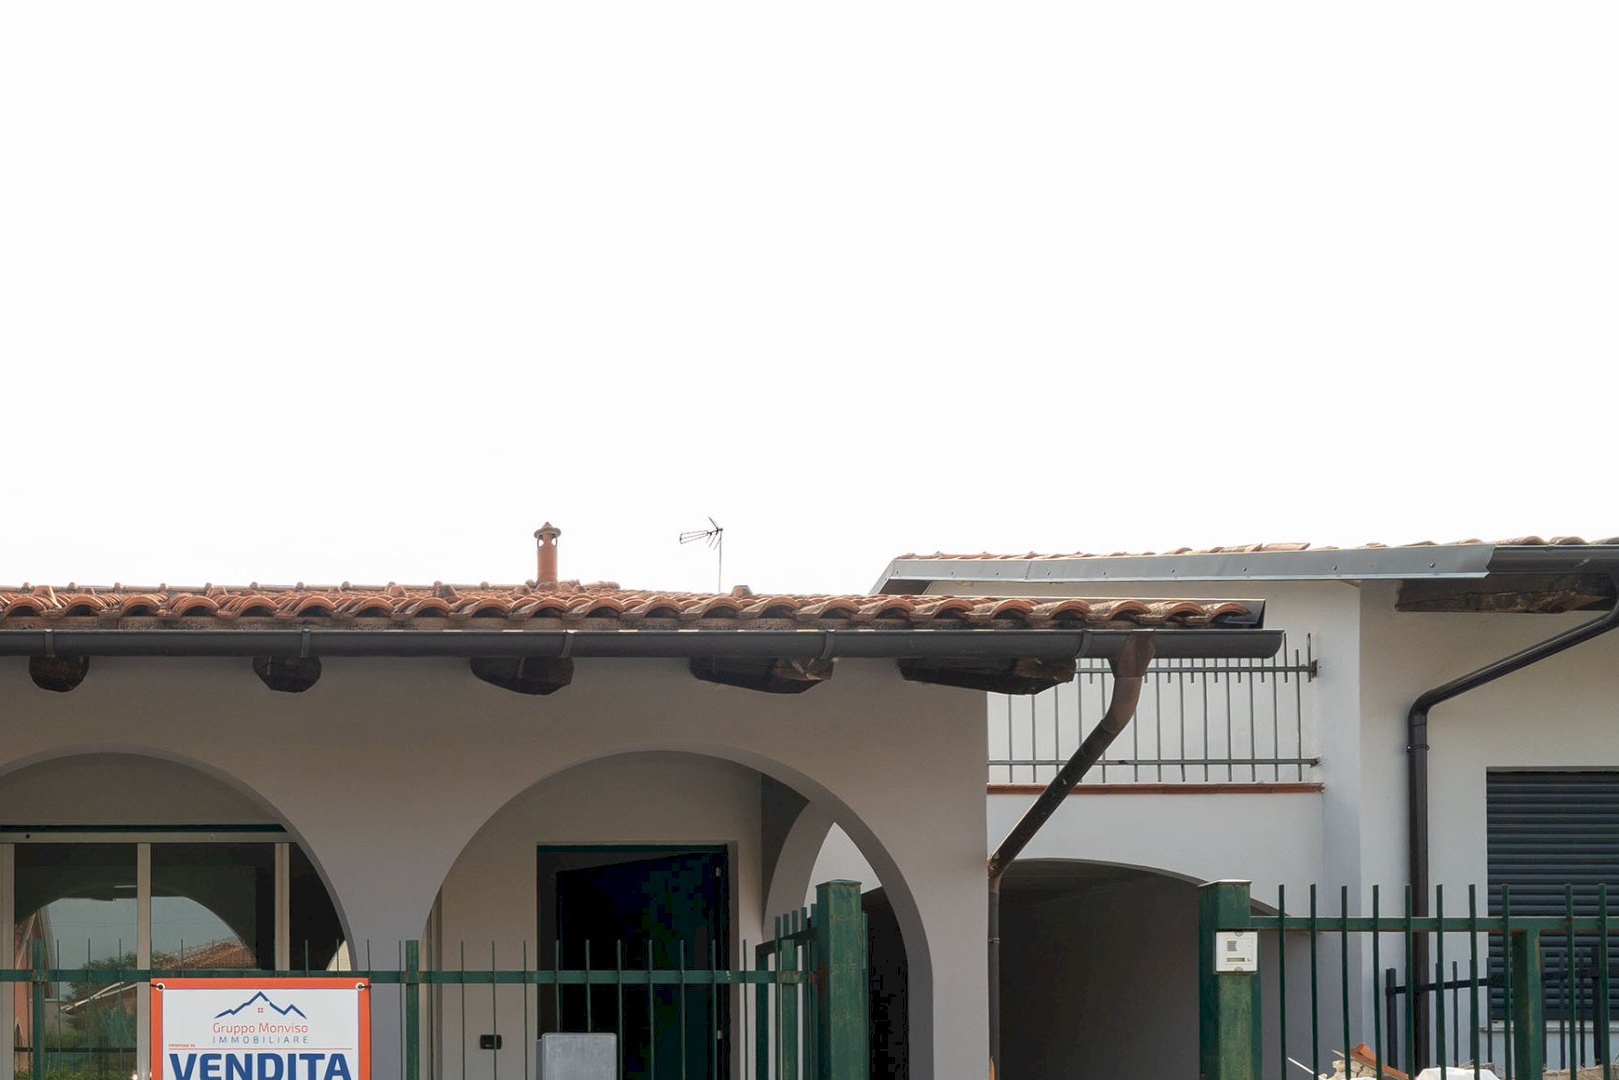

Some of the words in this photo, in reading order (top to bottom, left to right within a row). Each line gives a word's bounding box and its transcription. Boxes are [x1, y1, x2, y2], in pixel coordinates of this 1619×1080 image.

[212, 1022, 255, 1035] Gruppo
[258, 1022, 309, 1034] Monviso
[212, 1036, 309, 1044] IMMOBILIARE
